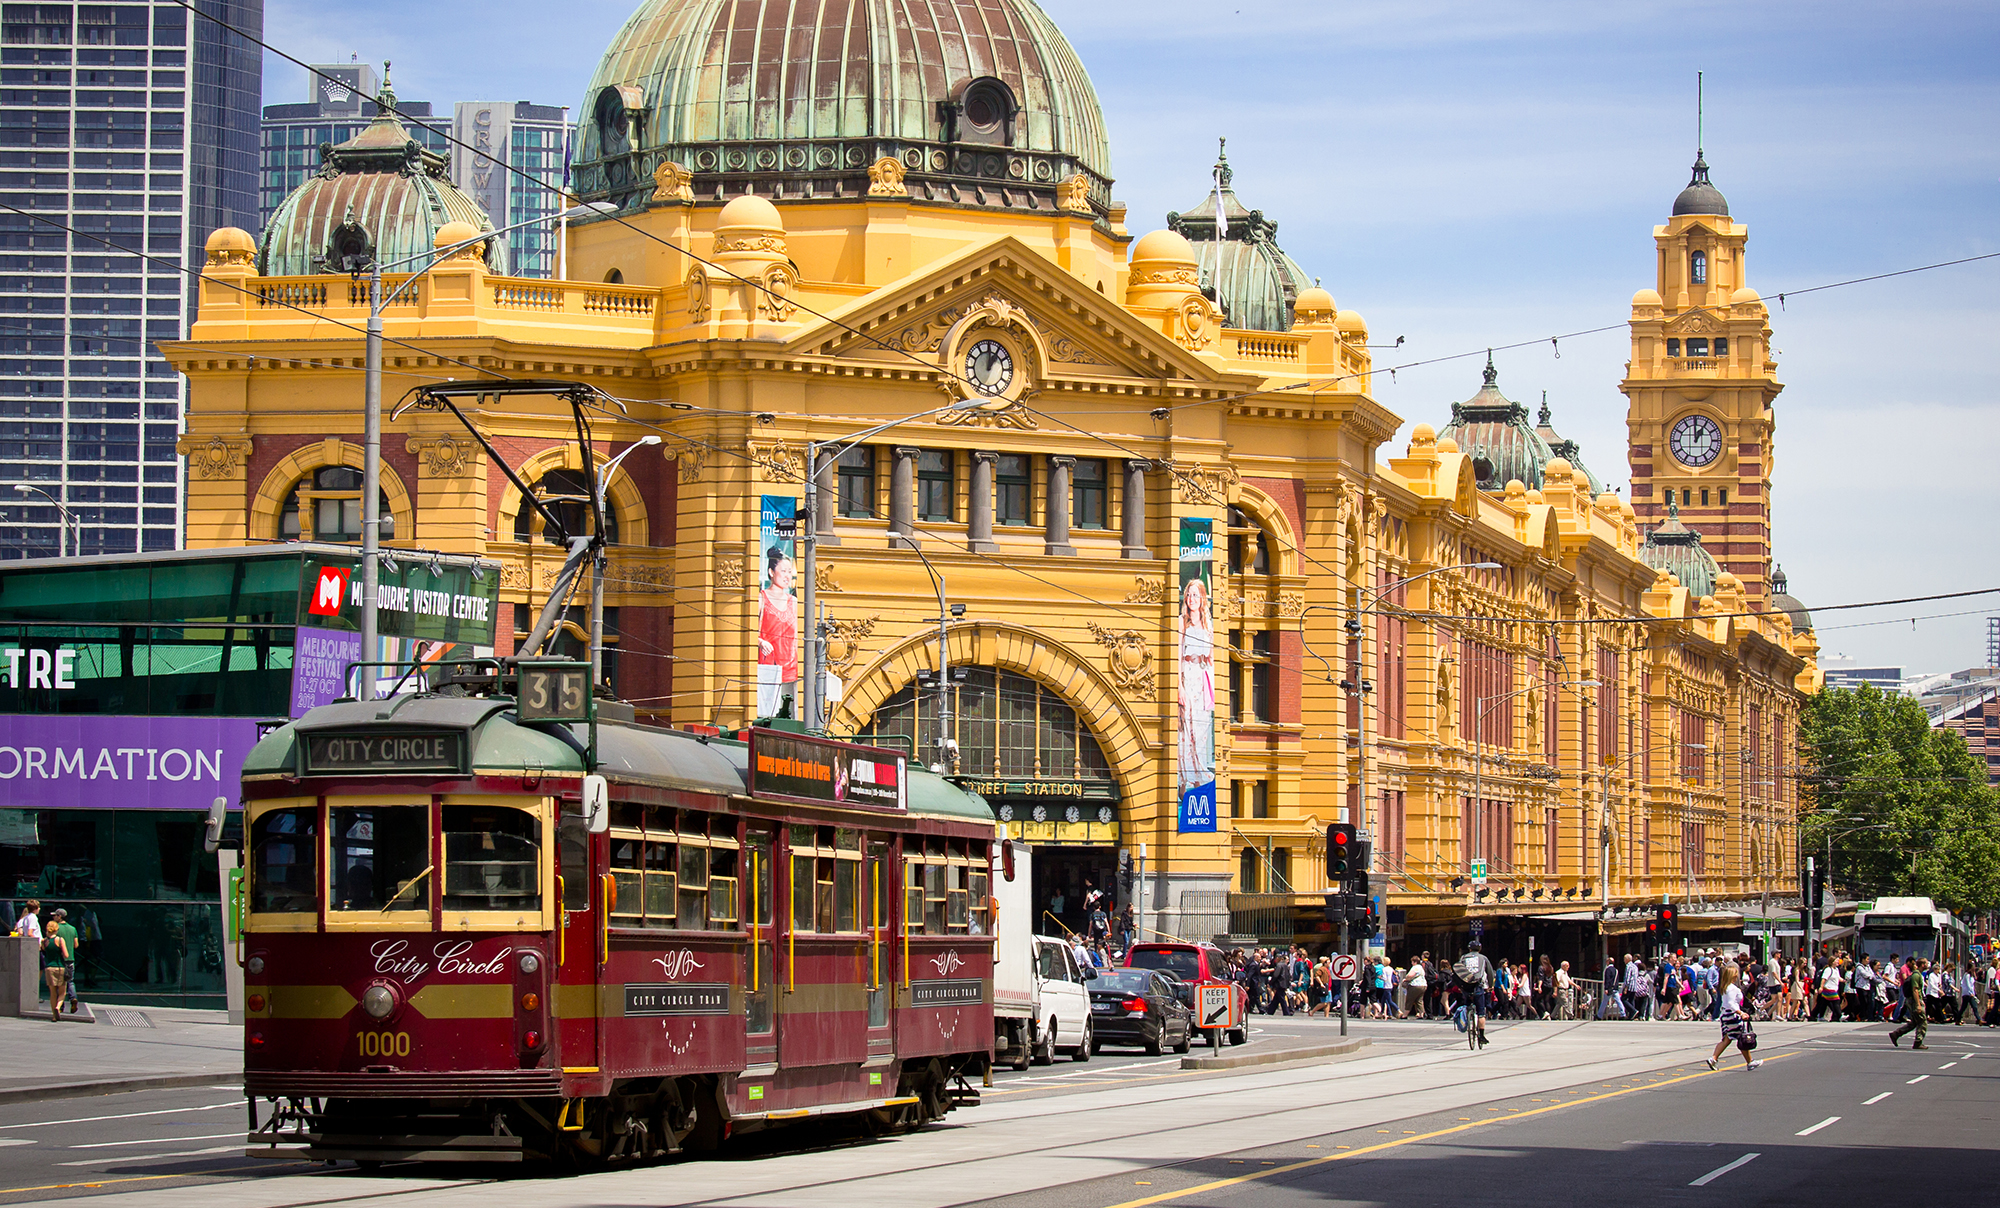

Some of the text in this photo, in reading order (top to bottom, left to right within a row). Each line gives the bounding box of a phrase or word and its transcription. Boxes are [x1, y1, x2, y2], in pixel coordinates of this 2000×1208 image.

[474, 109, 492, 210] CROWN
[763, 511, 779, 524] my
[1195, 532, 1211, 545] my
[1181, 546, 1211, 557] metro
[351, 581, 489, 622] MOURNE VISITOR CENTRE
[301, 637, 360, 661] MELBOURNE
[5, 648, 76, 689] TRE
[300, 657, 341, 680] FESTIVAL
[299, 677, 336, 694] 11-27 OCT
[297, 692, 315, 709] 2012
[328, 738, 445, 761] CITY CIRCLE
[0, 746, 223, 782] ORMATION
[1024, 782, 1083, 796] STATION
[370, 939, 512, 984] City Circle
[633, 995, 721, 1005] CITY CIRCLE TRAM
[917, 988, 977, 998] CITY CIRCLE TRAM
[1205, 989, 1226, 997] KEEP
[356, 1031, 410, 1057] 1000
